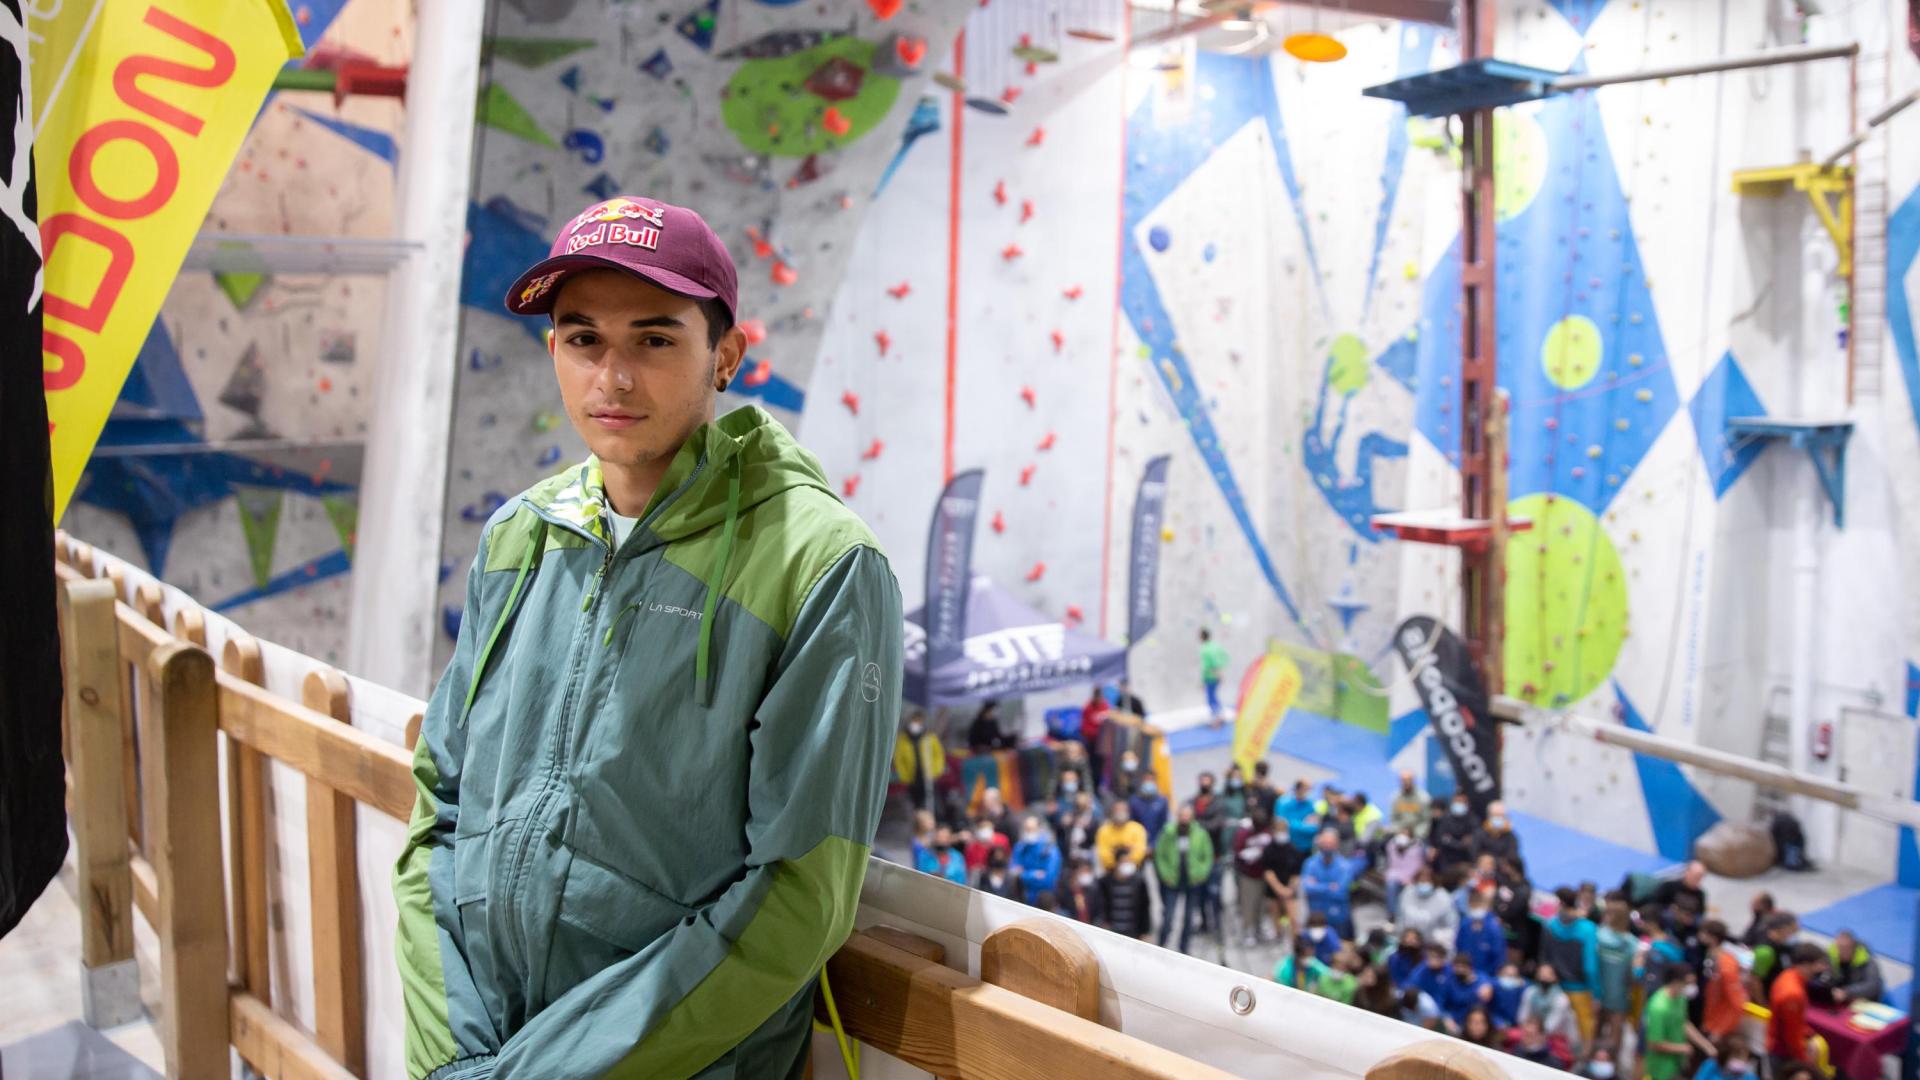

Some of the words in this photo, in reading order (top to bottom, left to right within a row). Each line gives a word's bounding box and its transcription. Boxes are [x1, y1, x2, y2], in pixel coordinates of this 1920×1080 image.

[41, 6, 236, 392] DON
[565, 223, 607, 255] Red
[607, 223, 660, 250] Bull
[649, 602, 663, 612] LA
[663, 605, 704, 620] SPORT
